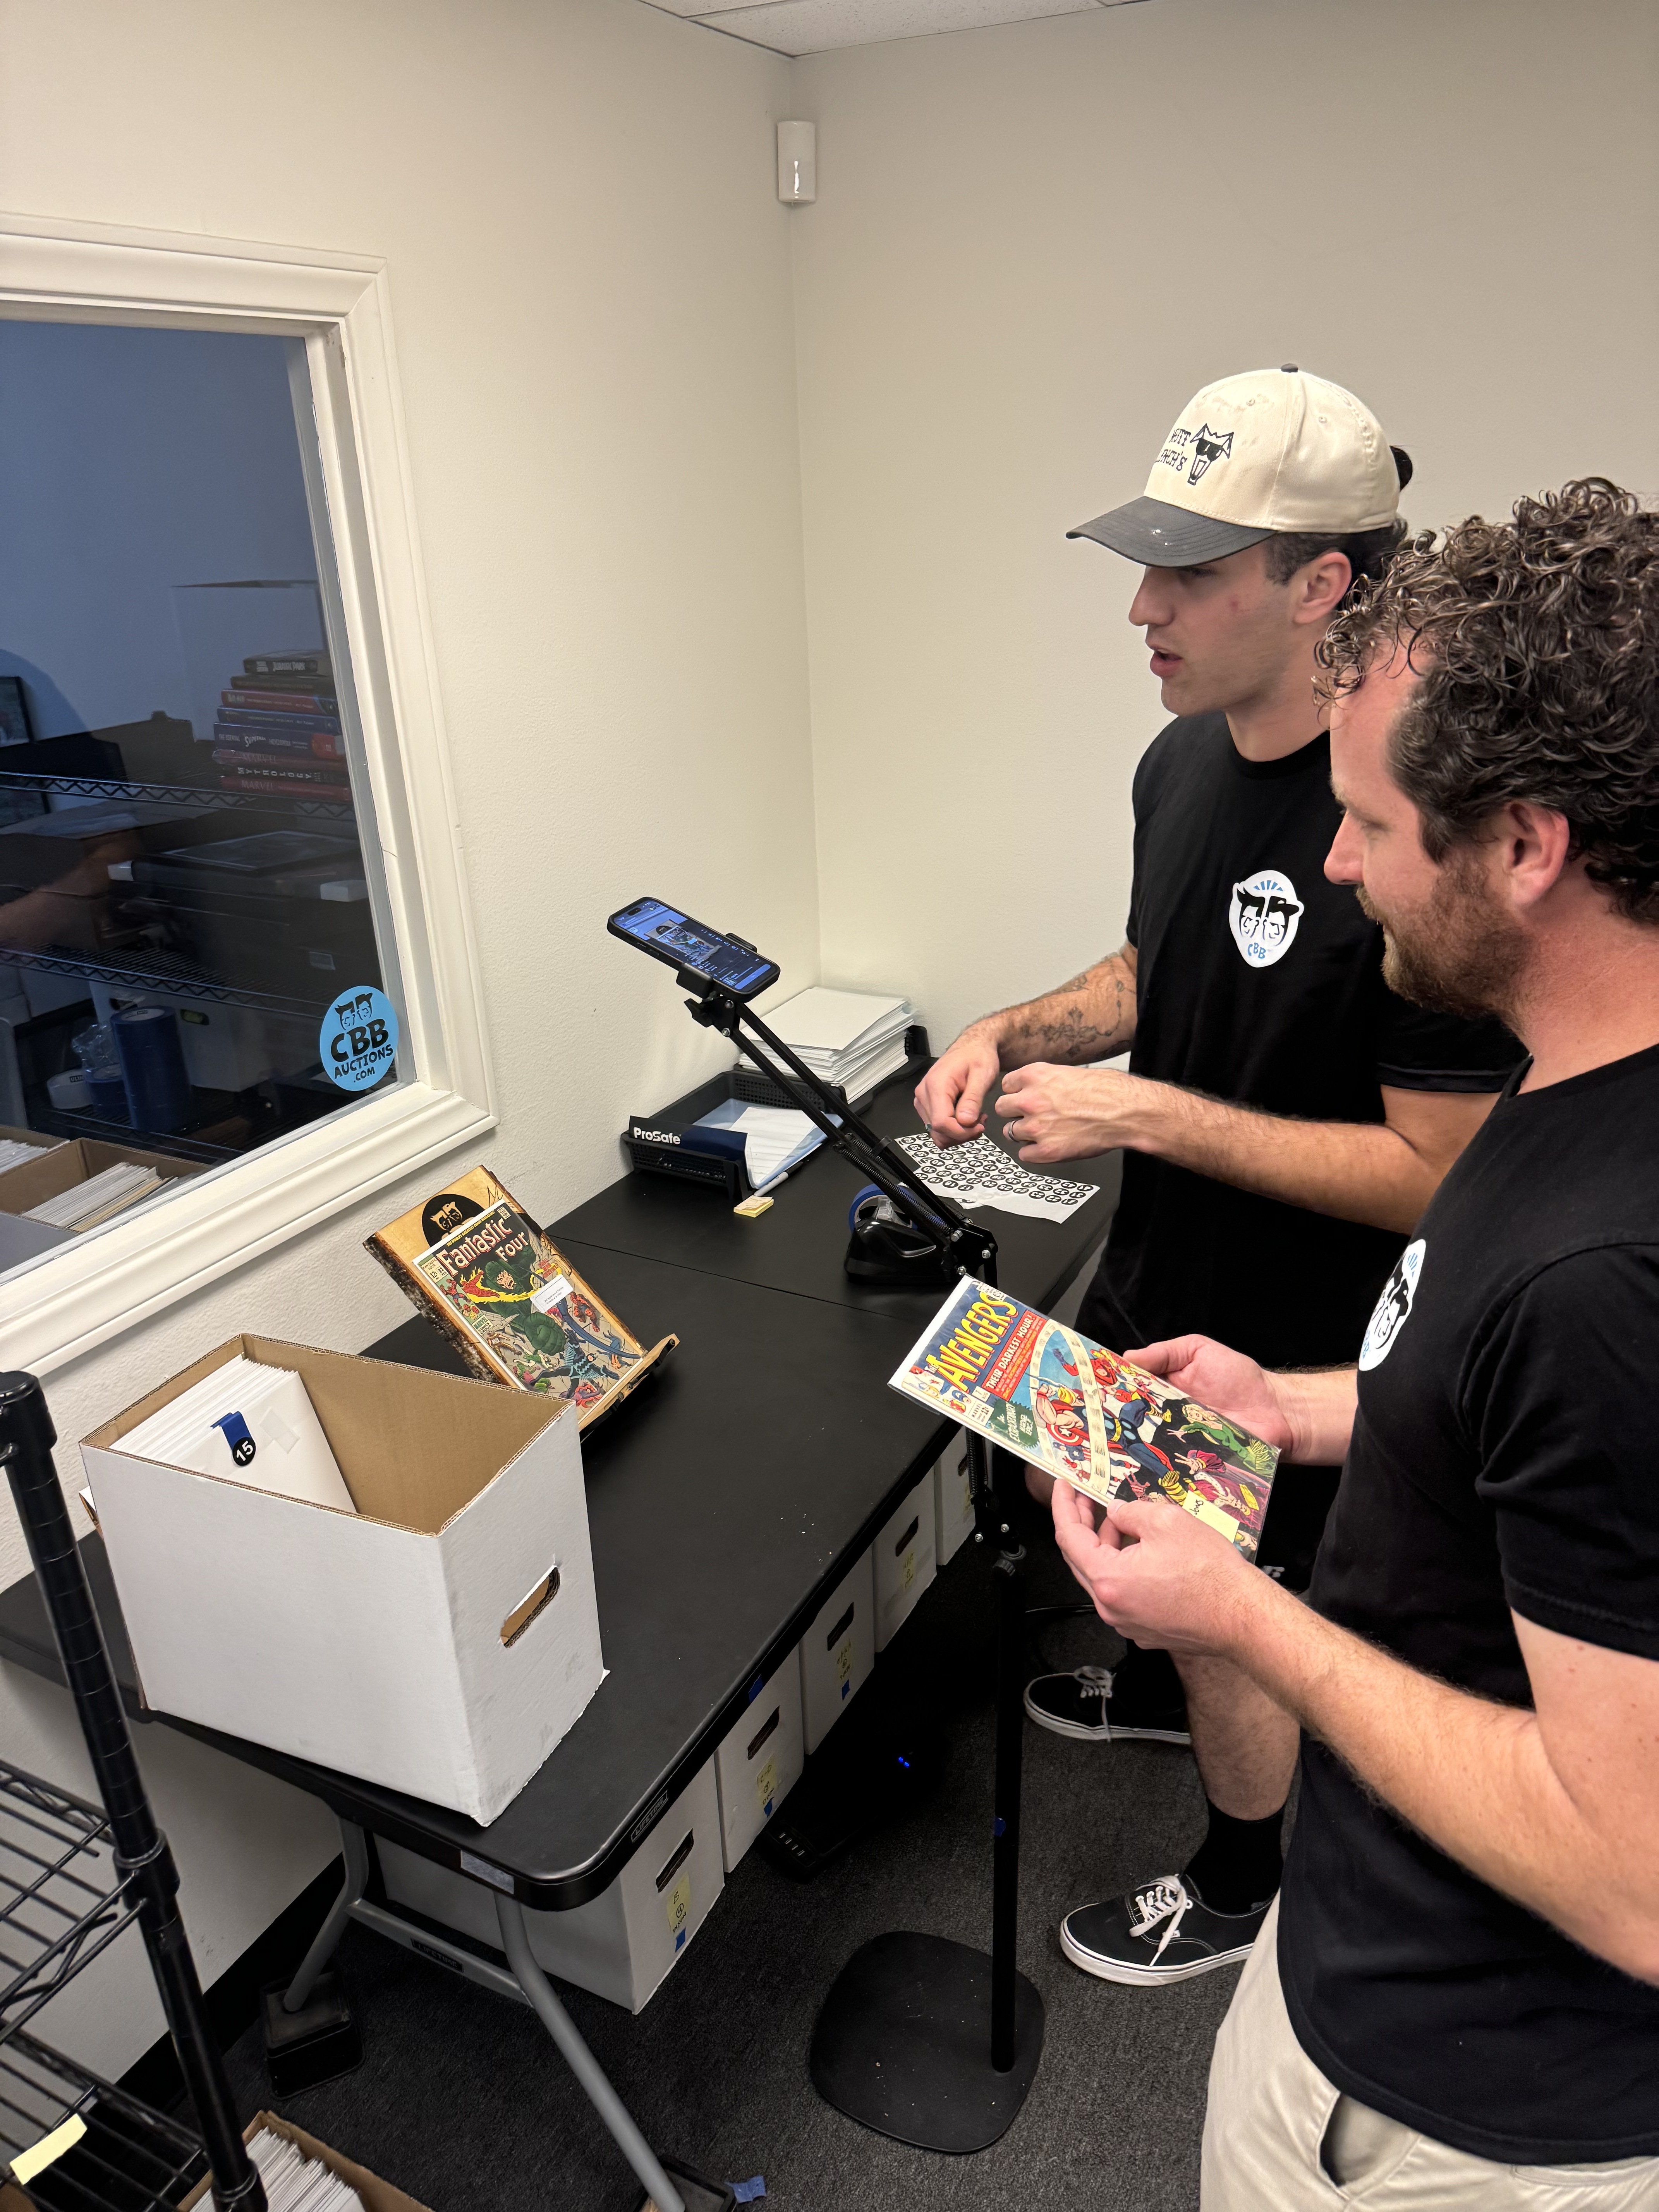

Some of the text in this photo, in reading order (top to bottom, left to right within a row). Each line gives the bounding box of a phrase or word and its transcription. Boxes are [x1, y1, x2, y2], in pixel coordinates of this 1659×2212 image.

[1247, 942, 1266, 959] CBB
[331, 1019, 389, 1062] CBB
[334, 1044, 393, 1079] AUCTIONS
[354, 1066, 375, 1082] .COM
[634, 1127, 681, 1145] ProSafe
[436, 1218, 513, 1278] Fantastic
[495, 1231, 529, 1262] Four
[926, 1292, 1018, 1394] AVENGERS
[986, 1314, 1035, 1389] THEIR DARKEST HOUR!
[925, 1362, 940, 1374] THE
[972, 1403, 982, 1418] MARVEL
[236, 1441, 253, 1461] 15
[635, 1796, 664, 1836] LIFETIME
